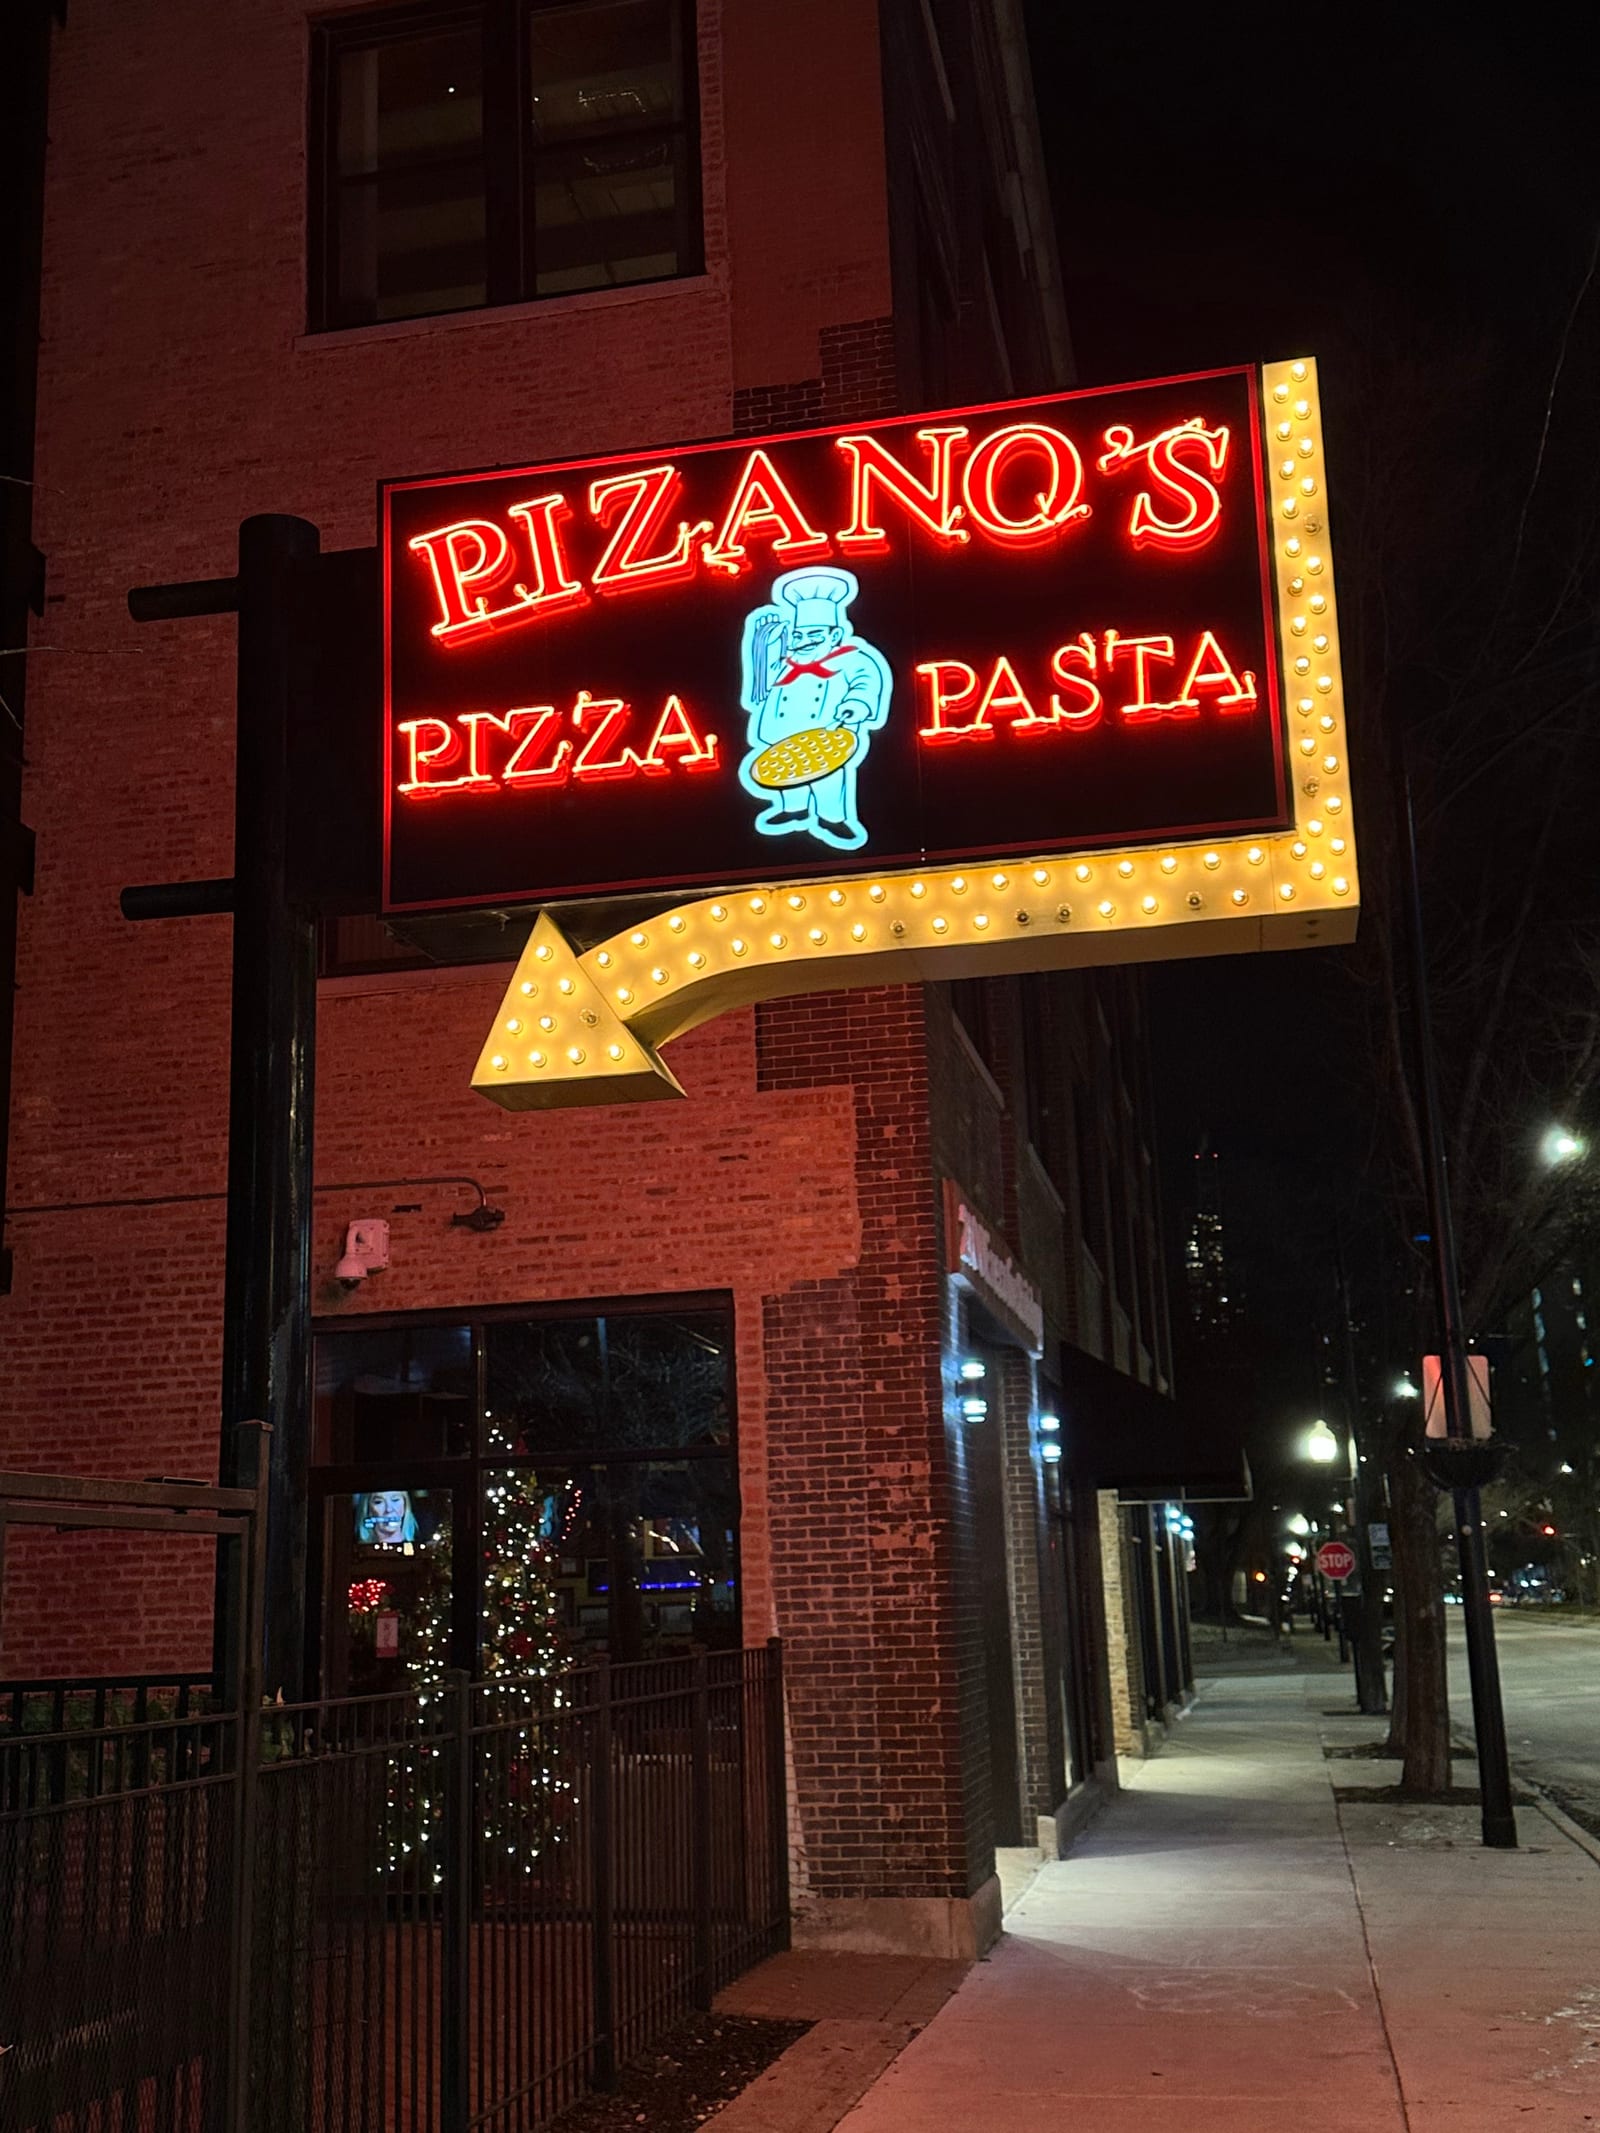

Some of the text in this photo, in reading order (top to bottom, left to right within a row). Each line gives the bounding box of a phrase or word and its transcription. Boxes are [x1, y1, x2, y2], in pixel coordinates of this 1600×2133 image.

[408, 418, 1230, 645] PIZANO'S
[398, 630, 1256, 797] PIZZA PASTA
[1321, 1554, 1352, 1568] STOP
